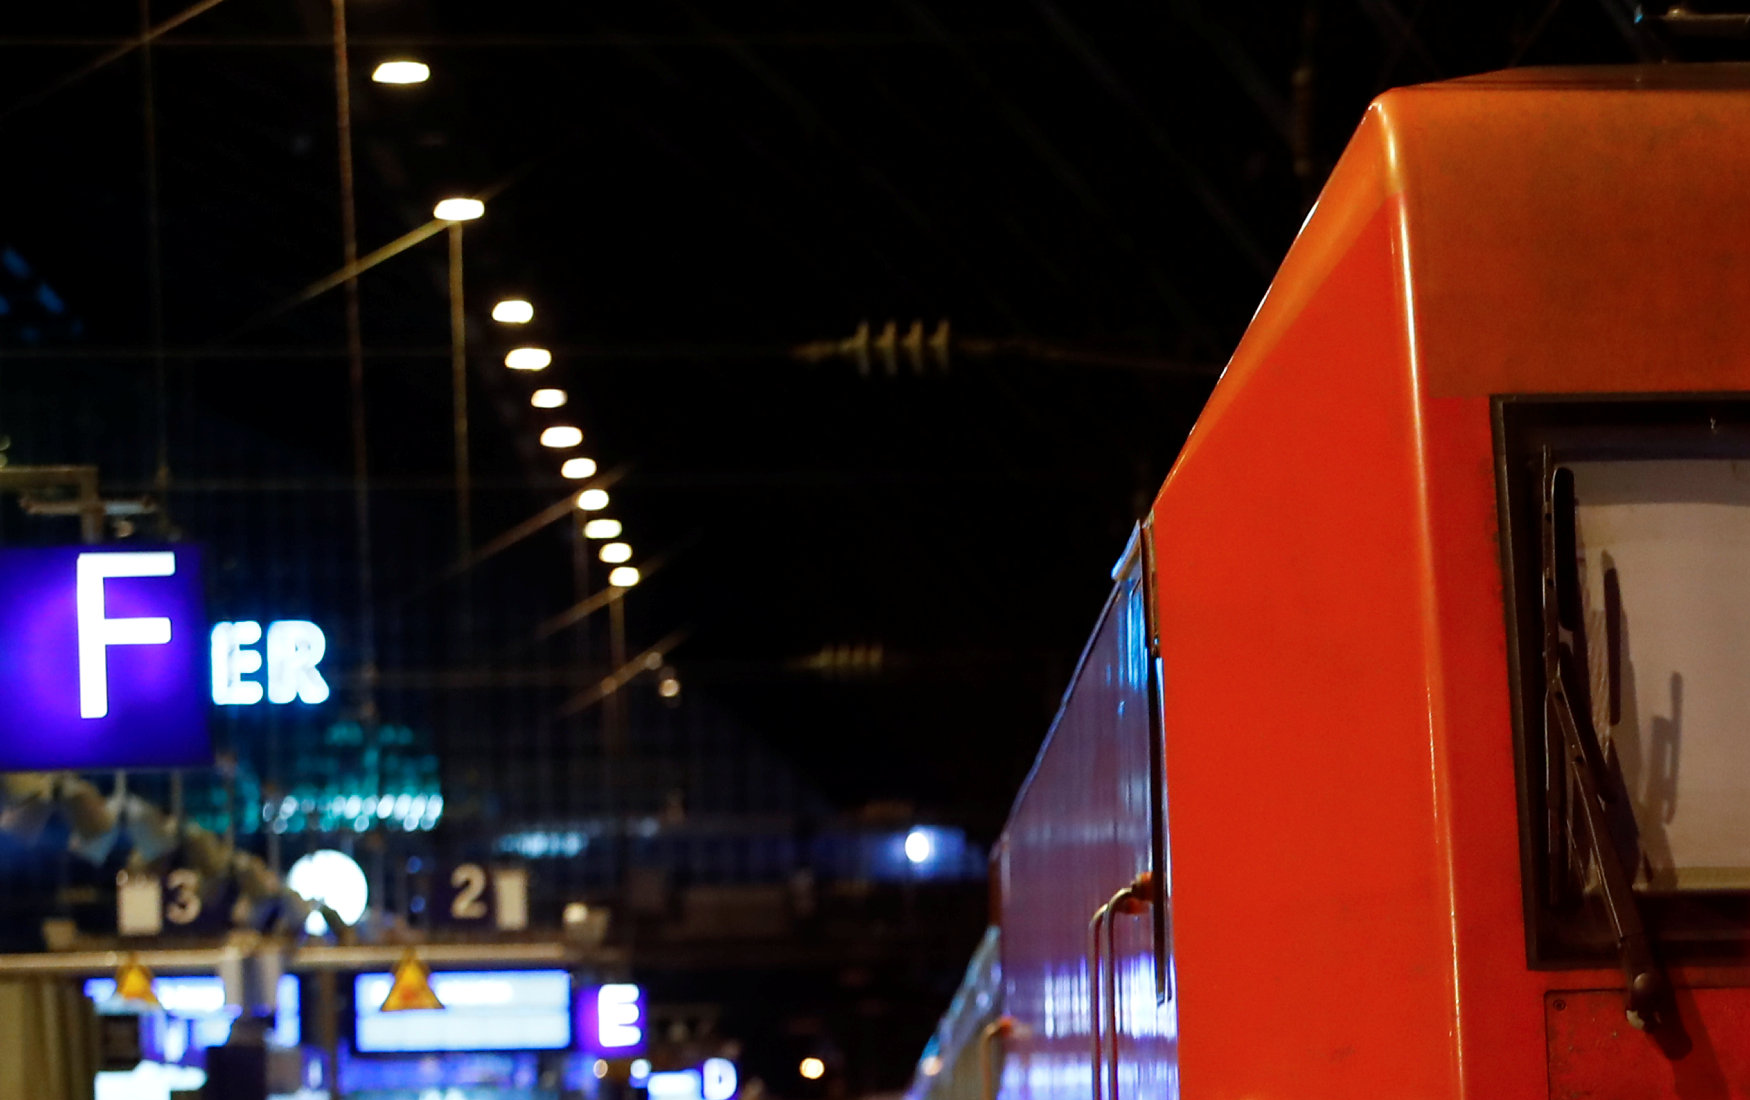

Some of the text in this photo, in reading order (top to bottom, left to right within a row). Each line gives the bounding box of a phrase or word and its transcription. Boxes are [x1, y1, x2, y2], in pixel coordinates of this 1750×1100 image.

[77, 551, 176, 719] F
[167, 868, 201, 924] 3
[450, 863, 488, 919] 2
[598, 983, 641, 1047] E
